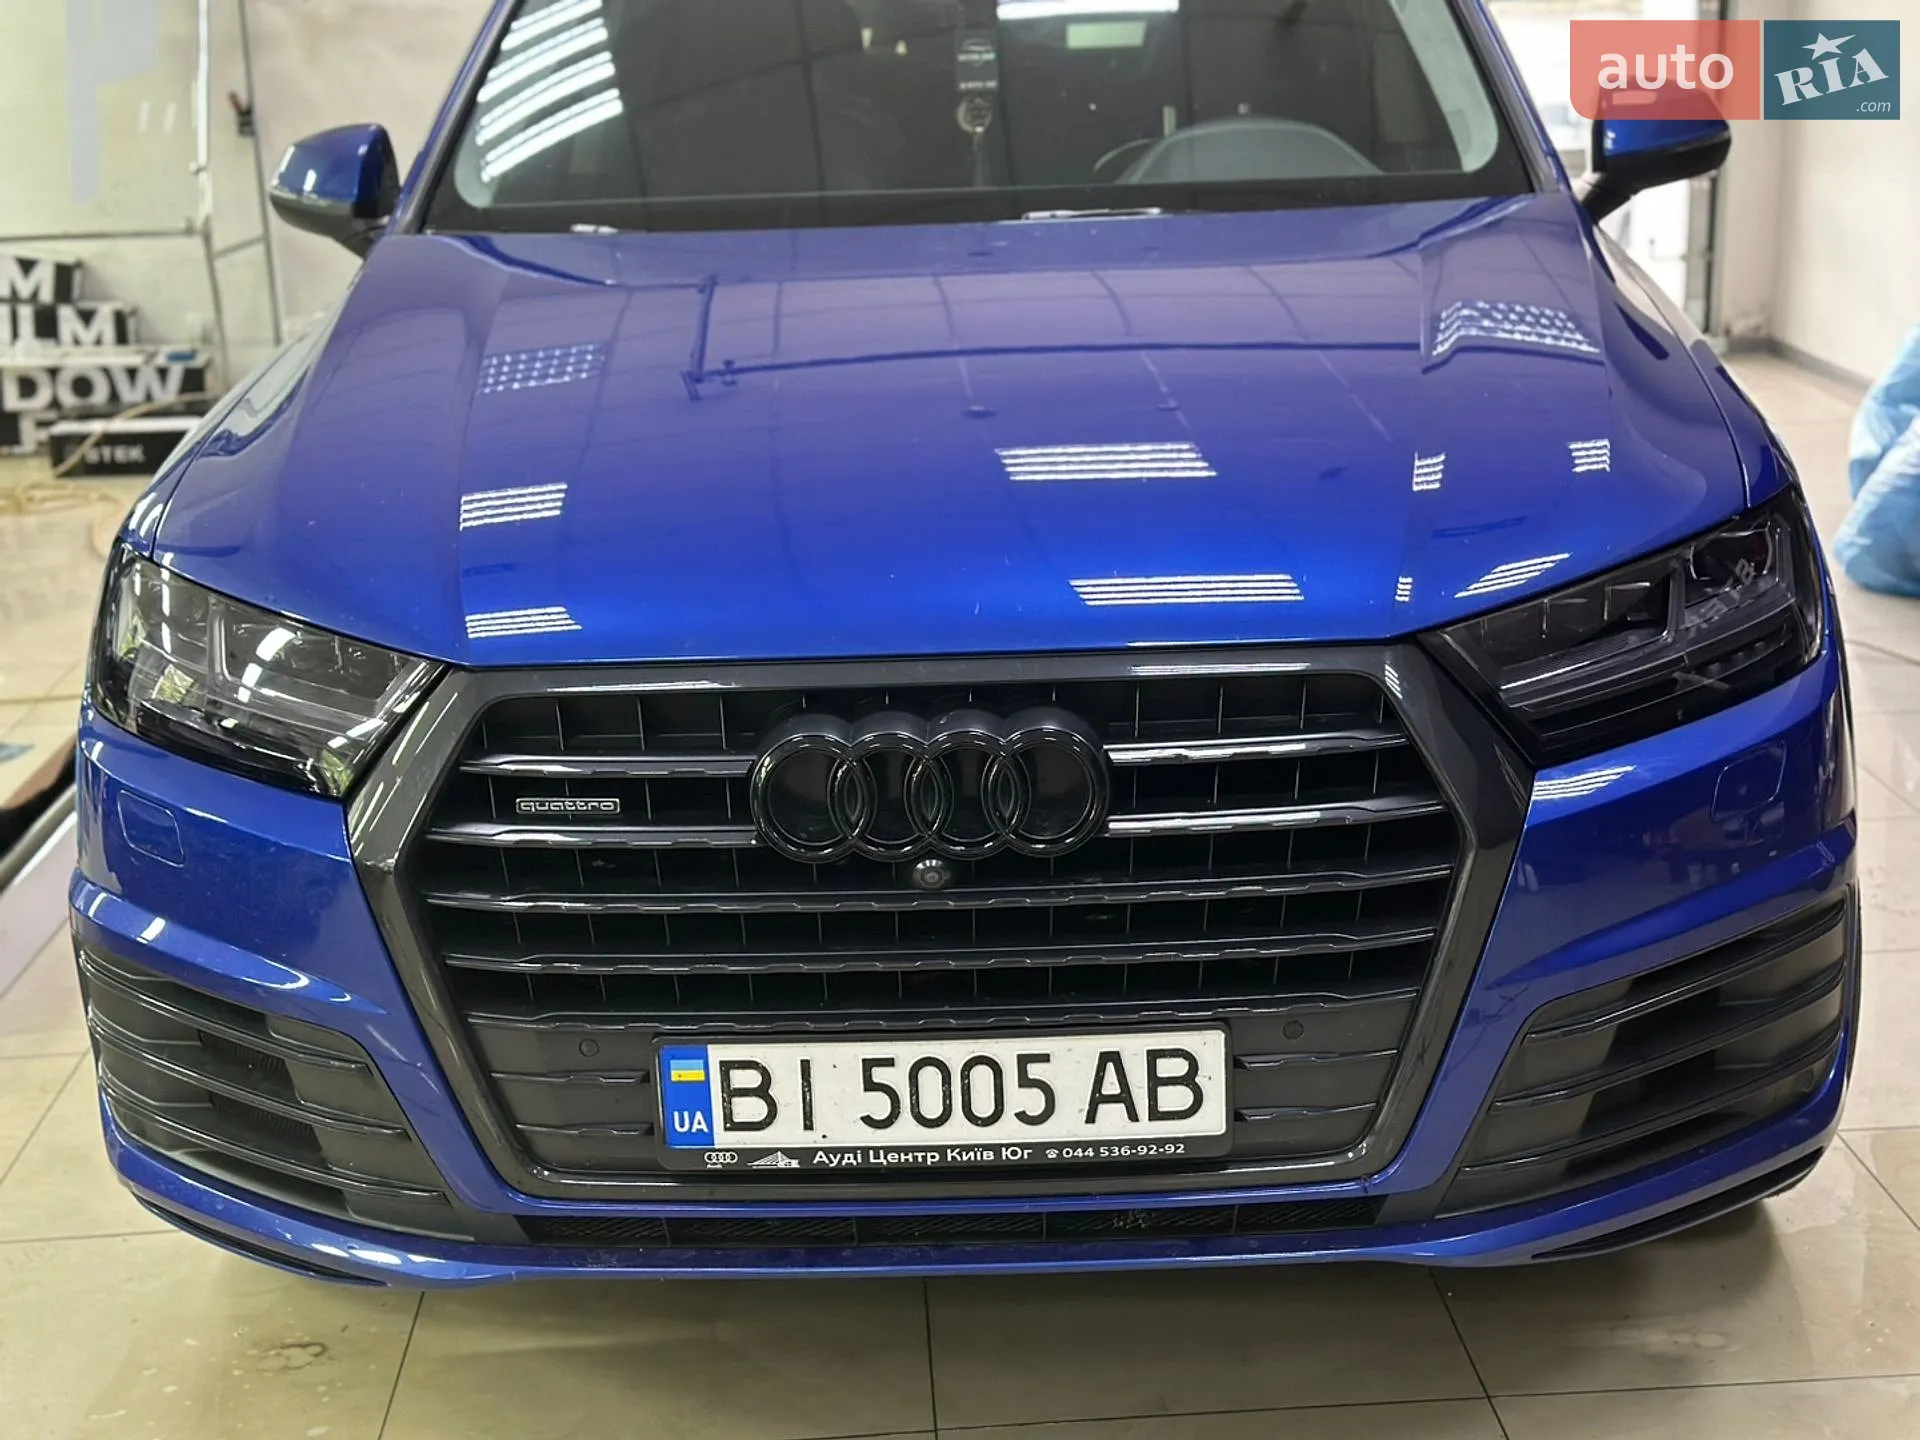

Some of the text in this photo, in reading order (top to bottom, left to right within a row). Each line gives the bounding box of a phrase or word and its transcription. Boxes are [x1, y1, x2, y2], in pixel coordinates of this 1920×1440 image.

[520, 800, 615, 812] quattro
[718, 1047, 1204, 1132] BI 5005 AB
[673, 1111, 709, 1133] UA
[813, 1142, 1186, 1168] Ауді Центр Київ Юг 044 536-92-92
